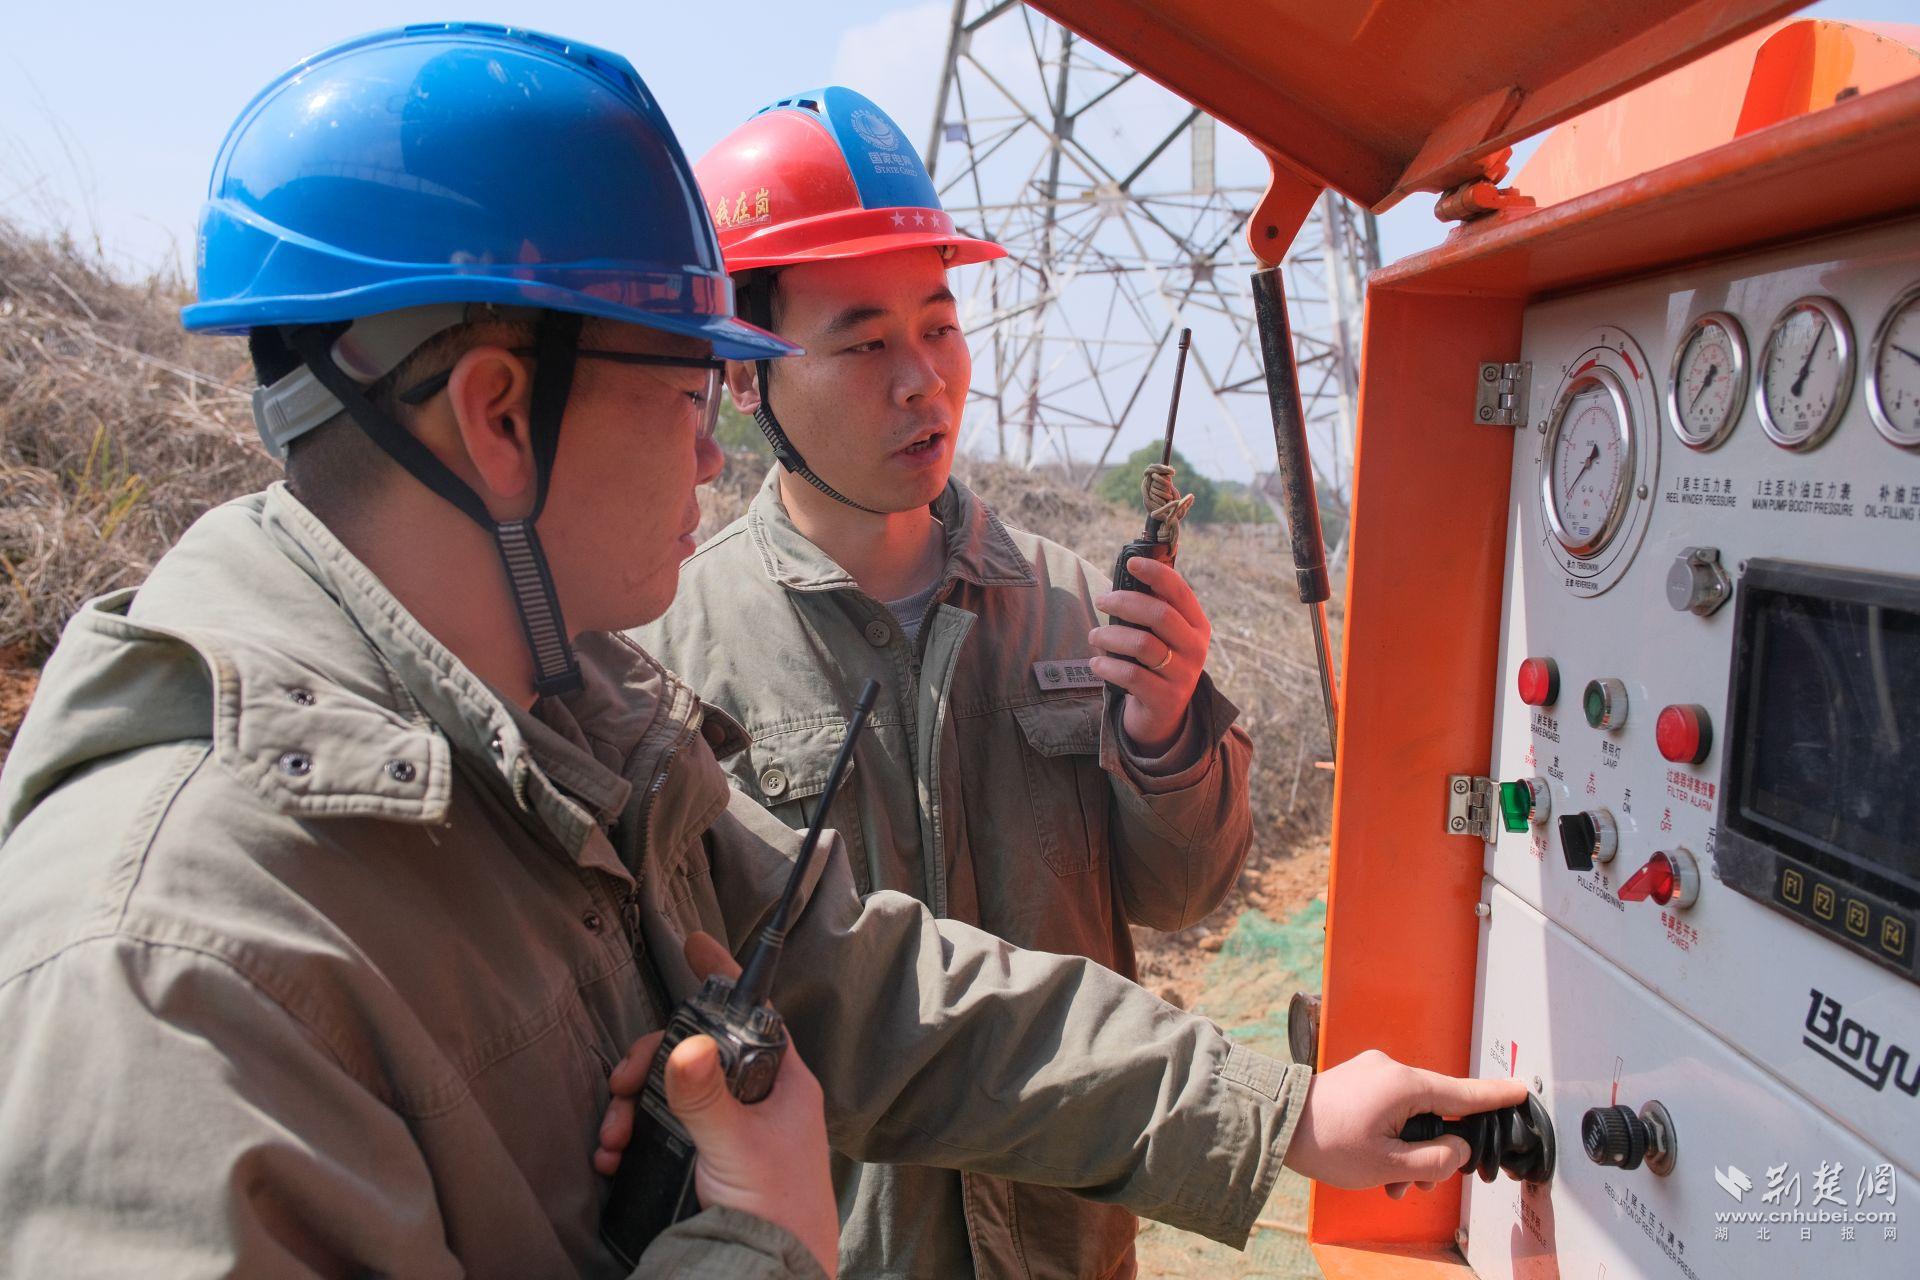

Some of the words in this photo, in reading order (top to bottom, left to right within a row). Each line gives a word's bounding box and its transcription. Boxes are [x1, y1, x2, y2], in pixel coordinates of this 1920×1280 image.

[868, 152, 914, 168] 国家电网
[706, 187, 769, 227] 我在岗
[1705, 494, 1736, 507] PRESSURE
[1752, 498, 1767, 510] MAIN
[1769, 499, 1787, 512] PUMP
[1814, 502, 1854, 517] PRESSURE
[1864, 504, 1914, 521] OIL-FILLING
[1603, 756, 1617, 769] LAMP
[1547, 765, 1564, 781] RELEASE
[1667, 785, 1688, 801] FILTER
[1690, 795, 1712, 812] ALARM
[1577, 875, 1595, 894] PULLEY
[1786, 877, 1798, 895] F1
[1817, 892, 1830, 912] F2
[1850, 908, 1864, 928] F3
[1667, 930, 1690, 951] POWER
[1886, 924, 1900, 945] F4
[1642, 1221, 1655, 1241] REEL
[1655, 1235, 1677, 1264] WINDER
[1677, 1257, 1700, 1280] PRESS
